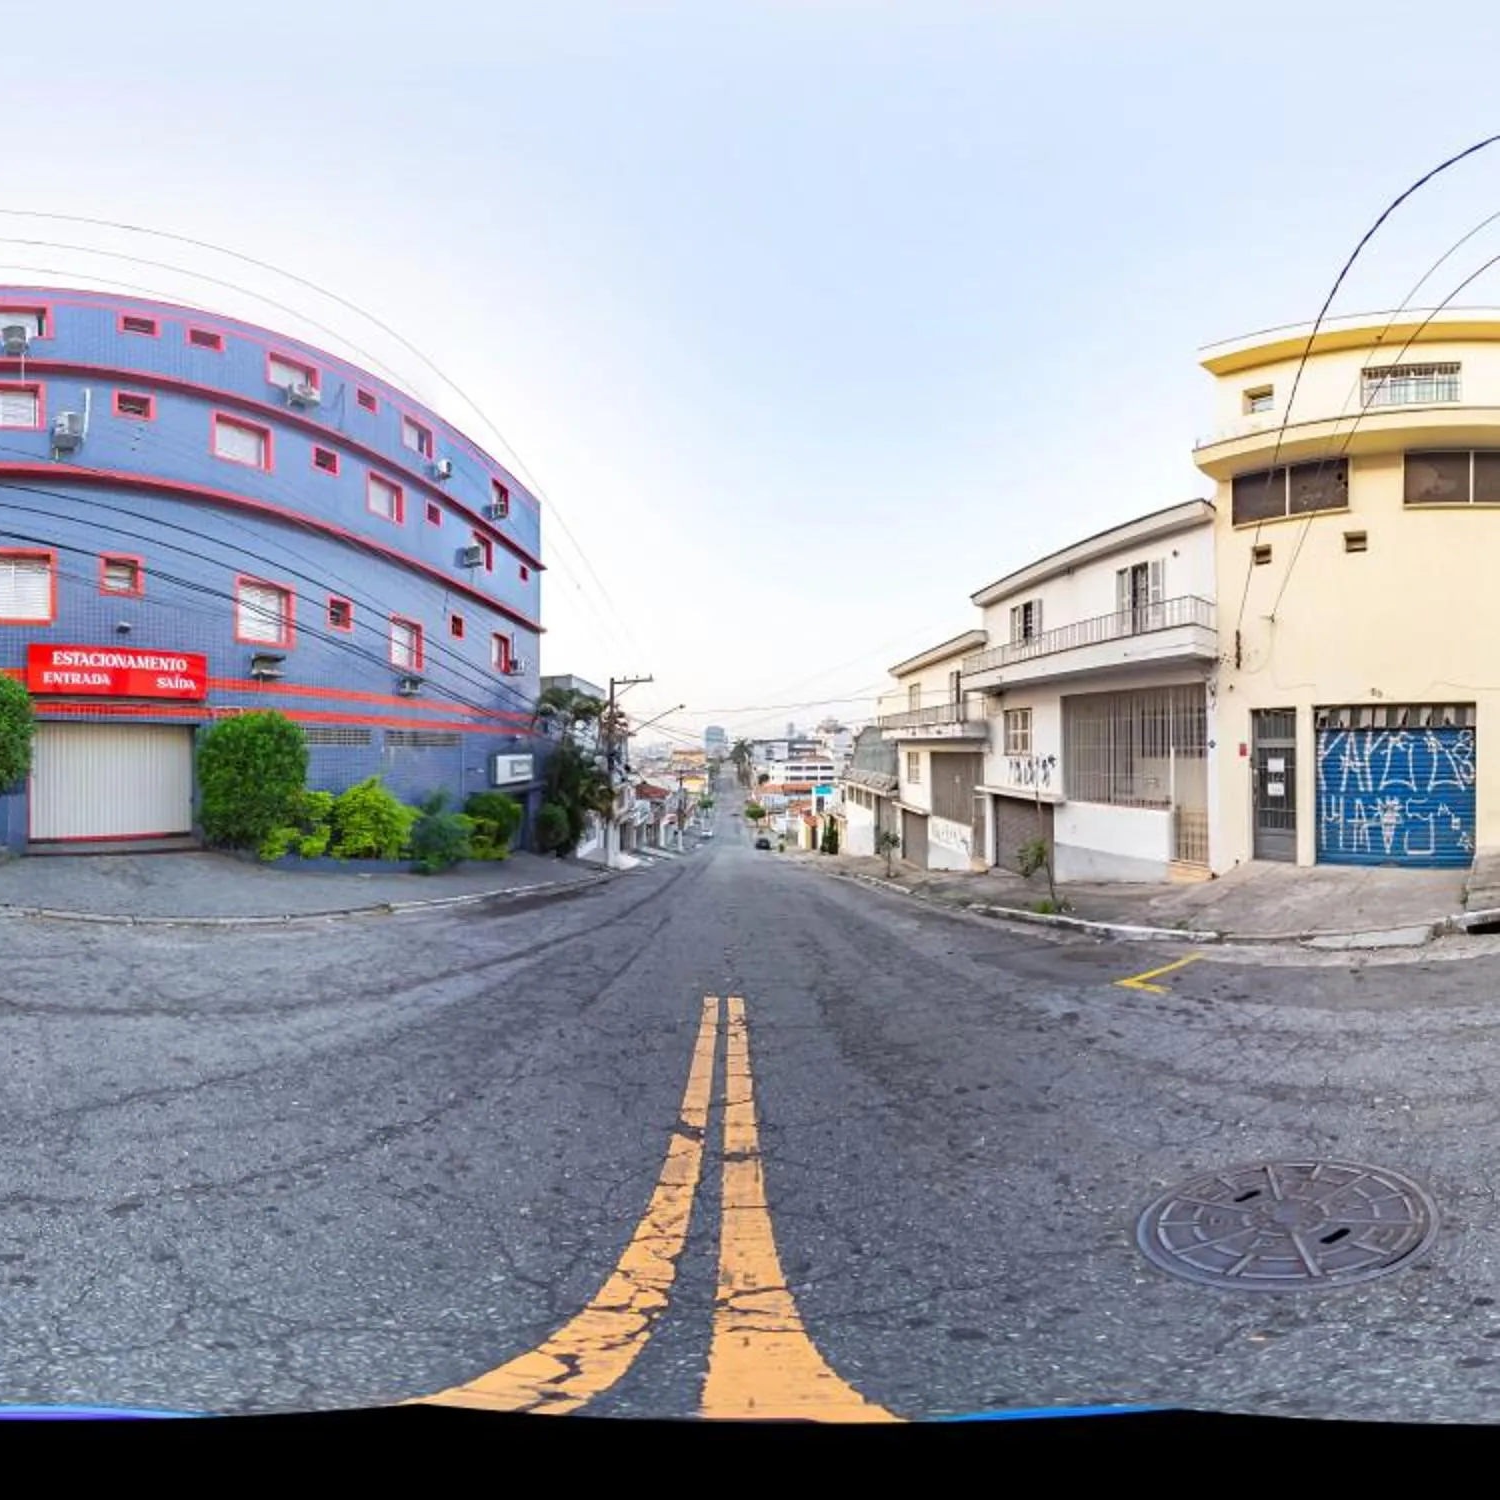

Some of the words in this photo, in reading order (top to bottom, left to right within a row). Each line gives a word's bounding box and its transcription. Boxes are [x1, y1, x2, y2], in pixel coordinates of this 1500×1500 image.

[52, 651, 188, 672] ESTACIONAMENTO
[42, 671, 111, 686] ENTRADA
[156, 674, 197, 690] SAÍDA
